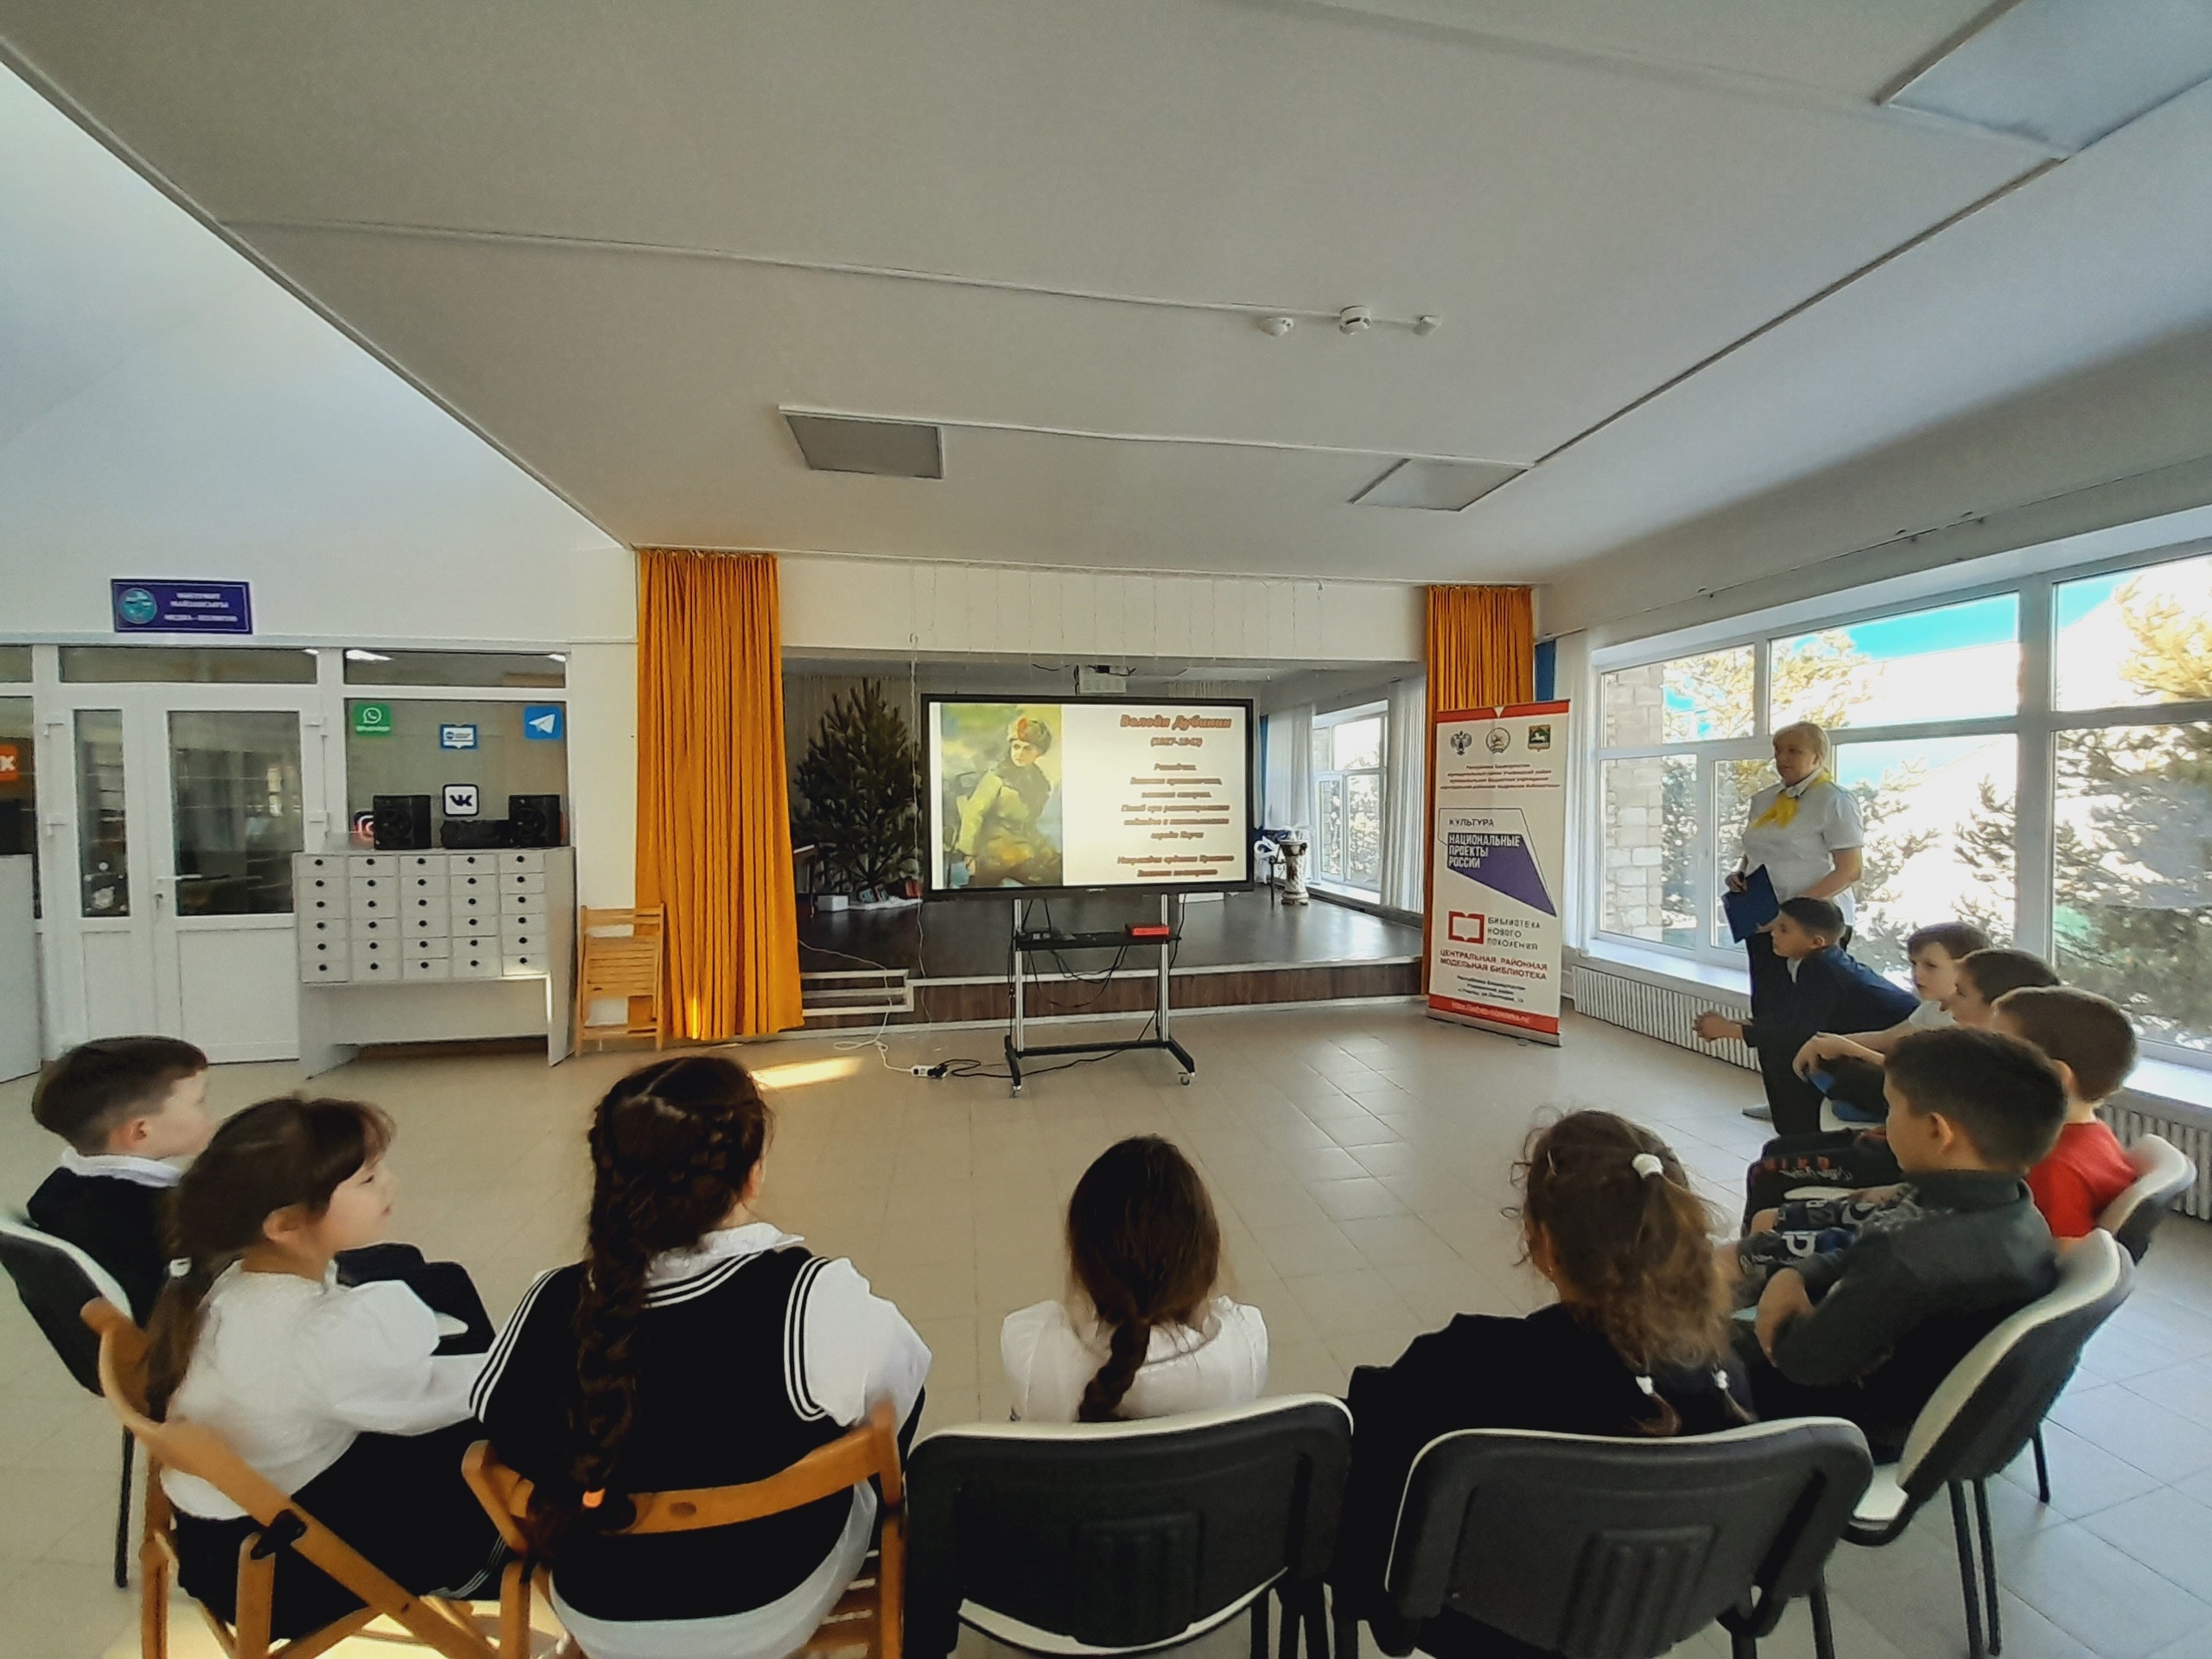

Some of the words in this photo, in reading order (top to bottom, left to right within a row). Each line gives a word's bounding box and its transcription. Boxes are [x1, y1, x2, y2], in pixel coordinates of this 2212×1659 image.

[1120, 715, 1170, 728] Володя
[1171, 715, 1232, 731] Дубинин
[1449, 818, 1494, 827] КУЛЬТУРА
[1449, 834, 1521, 847] НАЦИОНАЛЬНЫЕ
[1448, 845, 1489, 857] ПРОЕКТЫ
[1448, 856, 1481, 868] РОССИИ
[1488, 917, 1541, 929] БИБЛИОТЕКА
[1487, 927, 1522, 938] НОВОГО
[1486, 938, 1538, 950] ПОКОЛЕНИЯ
[1440, 950, 1497, 963] ЦЕНТРАЛЬНАЯ
[1500, 957, 1548, 971] РАЙОННАЯ
[1440, 957, 1488, 971] МОДЕЛЬНАЯ
[1490, 965, 1548, 981] БИБЛИОТЕКА
